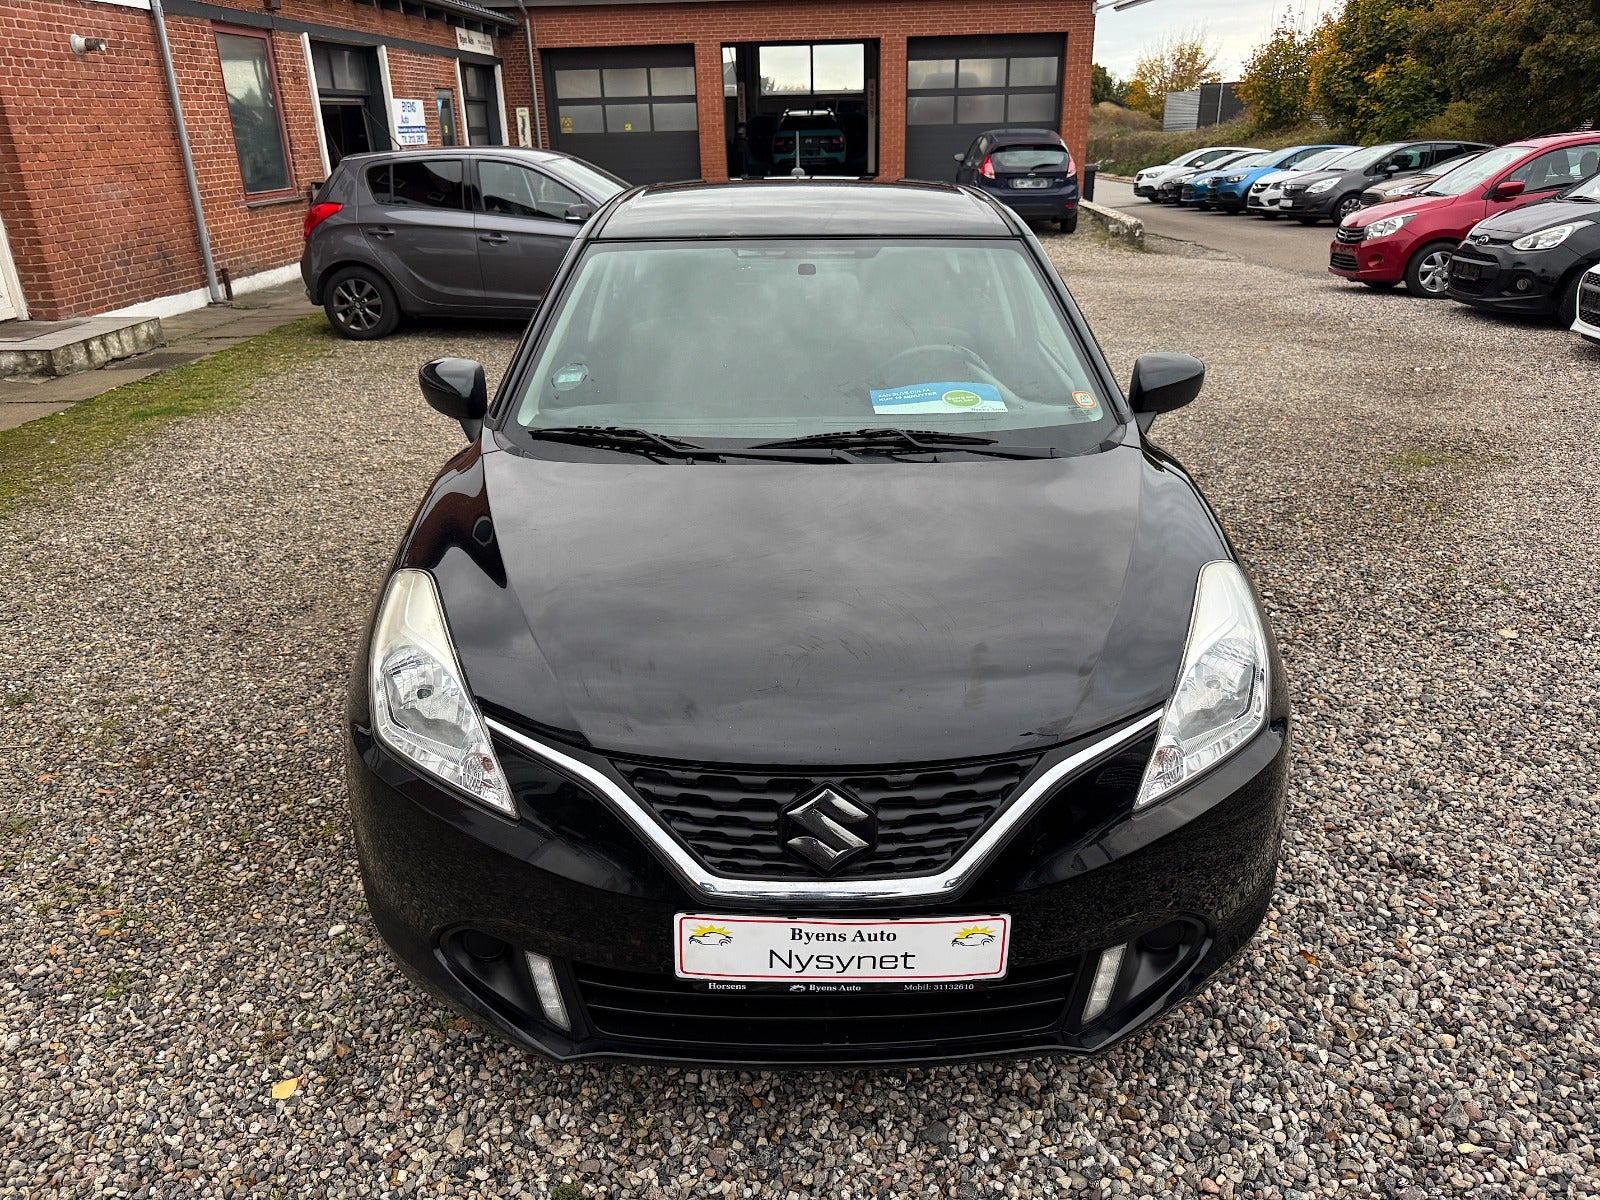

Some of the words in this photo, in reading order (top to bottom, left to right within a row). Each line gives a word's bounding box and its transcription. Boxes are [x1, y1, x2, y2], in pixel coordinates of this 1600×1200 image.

[402, 101, 416, 112] BYENS
[903, 391, 938, 399] MINUTTER
[790, 927, 847, 944] Byens
[851, 928, 897, 942] Auto
[769, 949, 916, 973] Nysynet
[809, 984, 838, 992] Byens
[839, 983, 861, 991] Auto
[933, 983, 975, 991] 31132610
